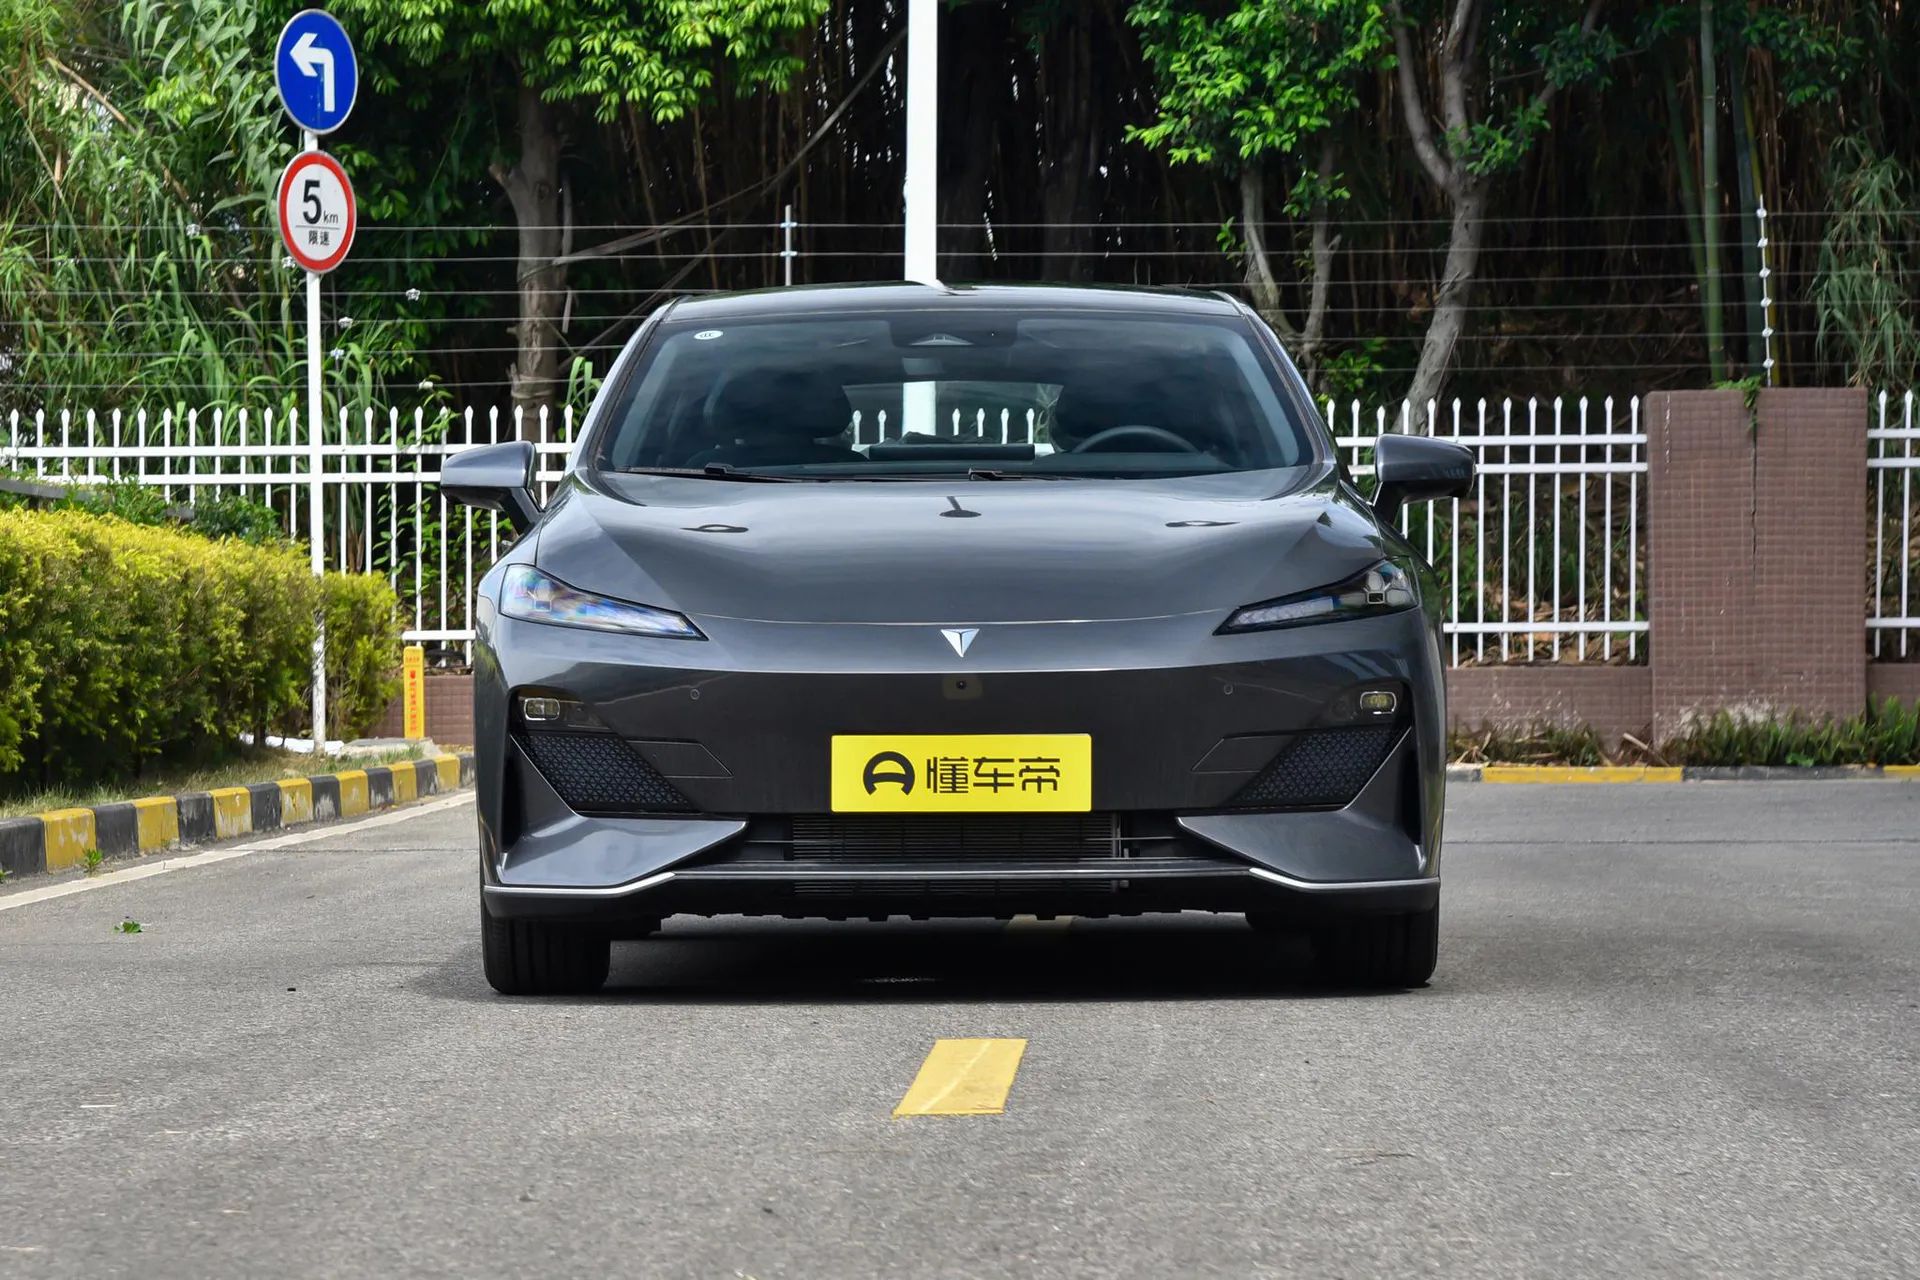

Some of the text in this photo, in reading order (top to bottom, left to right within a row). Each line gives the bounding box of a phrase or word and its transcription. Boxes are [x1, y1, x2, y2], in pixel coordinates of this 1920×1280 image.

[302, 179, 339, 225] 5 km
[308, 229, 330, 246] 限速
[926, 756, 1061, 794] 懂车帝
